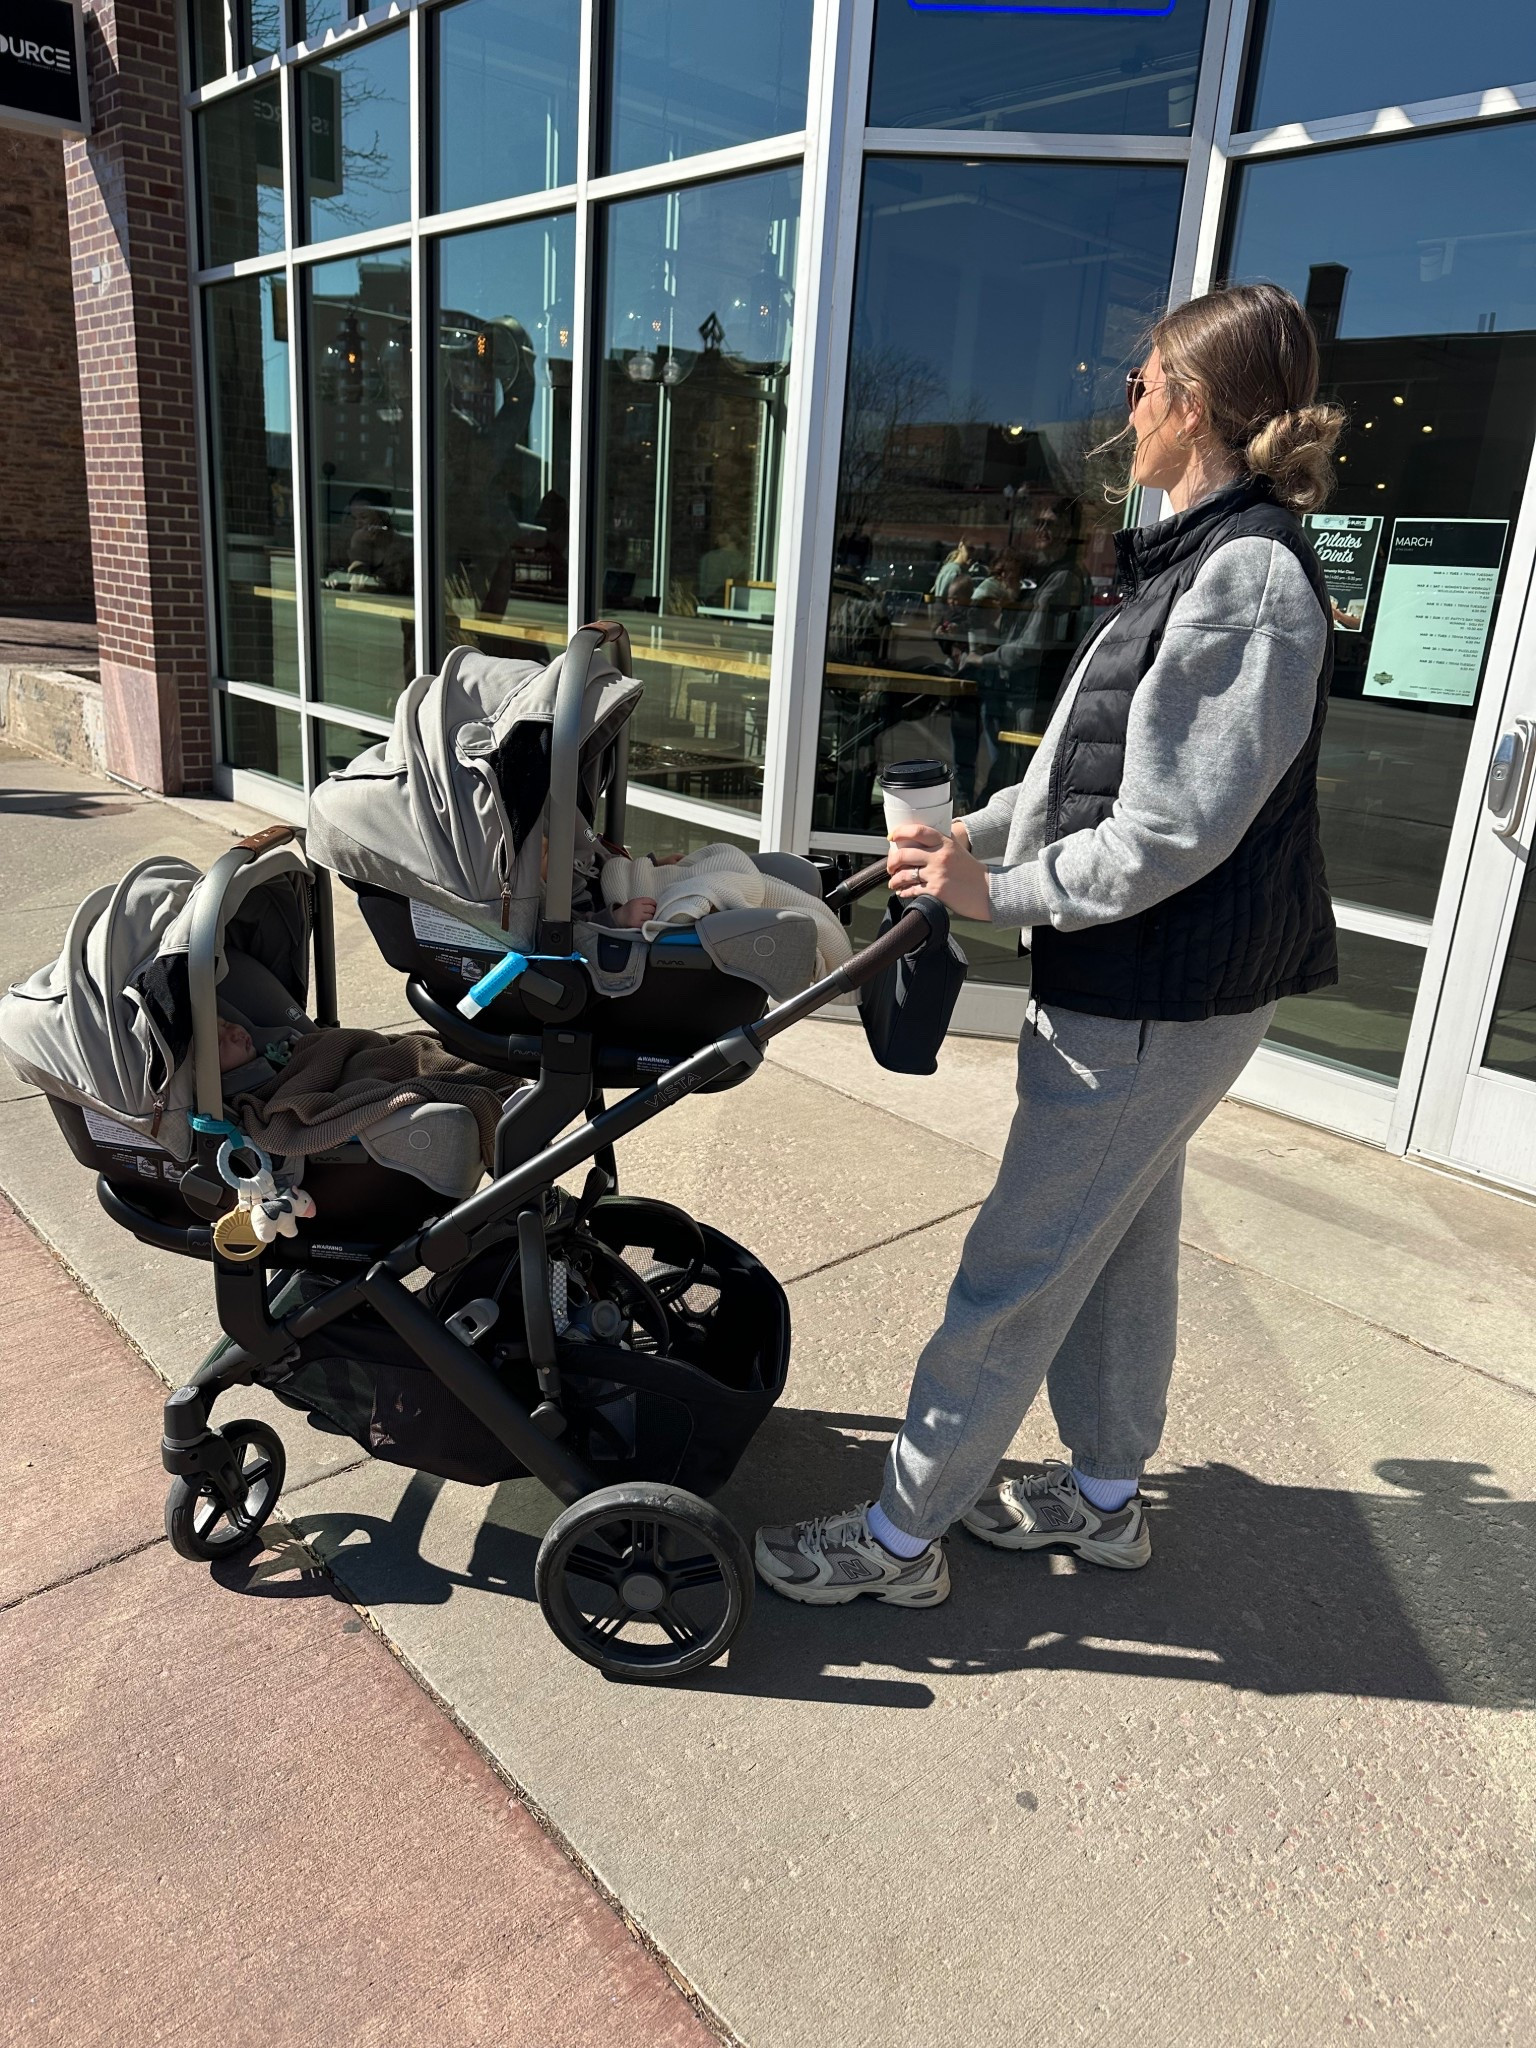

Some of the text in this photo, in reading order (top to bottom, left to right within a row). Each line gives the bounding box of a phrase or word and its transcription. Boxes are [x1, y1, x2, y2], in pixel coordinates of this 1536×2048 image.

[1313, 531, 1363, 549] Pilates
[1395, 537, 1434, 547] MARCH
[1320, 549, 1354, 563] Dints
[642, 1056, 670, 1065] WARNING
[643, 1072, 702, 1108] VISTA
[316, 1244, 343, 1252] WARNING
[1039, 1504, 1073, 1527] N
[837, 1558, 872, 1580] N
